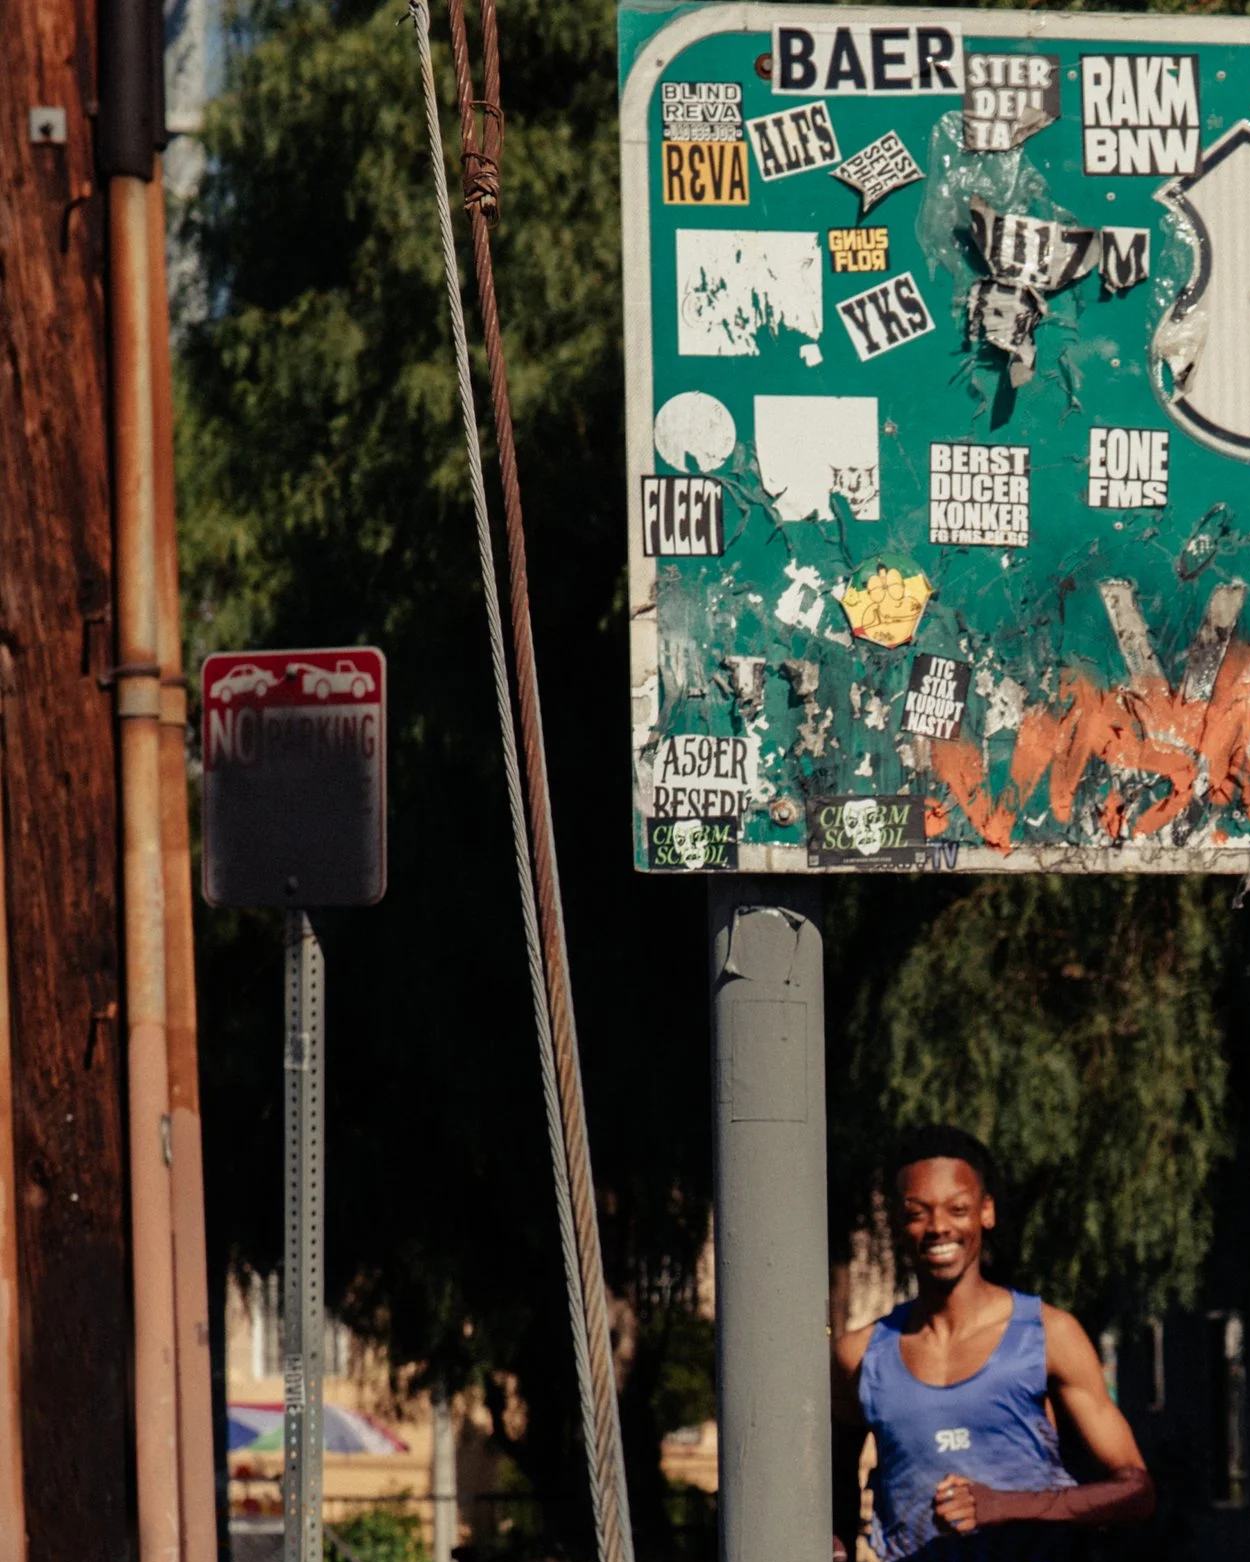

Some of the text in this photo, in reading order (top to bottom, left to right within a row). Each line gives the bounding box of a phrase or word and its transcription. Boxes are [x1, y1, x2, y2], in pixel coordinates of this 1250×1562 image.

[779, 27, 957, 90] BAER
[968, 54, 1051, 86] STER
[662, 83, 742, 102] BLIND
[1082, 56, 1200, 126] RAKM
[663, 102, 742, 122] REVA
[753, 105, 835, 177] ALFS
[1084, 129, 1200, 174] BNW
[841, 277, 927, 354] YKS
[930, 443, 1029, 475] BERST
[930, 473, 1029, 504] DUCER
[1088, 478, 1168, 508] FMS
[644, 478, 722, 554] FLEET
[930, 501, 1029, 532] KONKER
[929, 657, 956, 680] ITC
[920, 676, 957, 701] STAX
[905, 692, 964, 721] KURUPT
[210, 705, 258, 765] NO
[907, 711, 956, 740] NASTY
